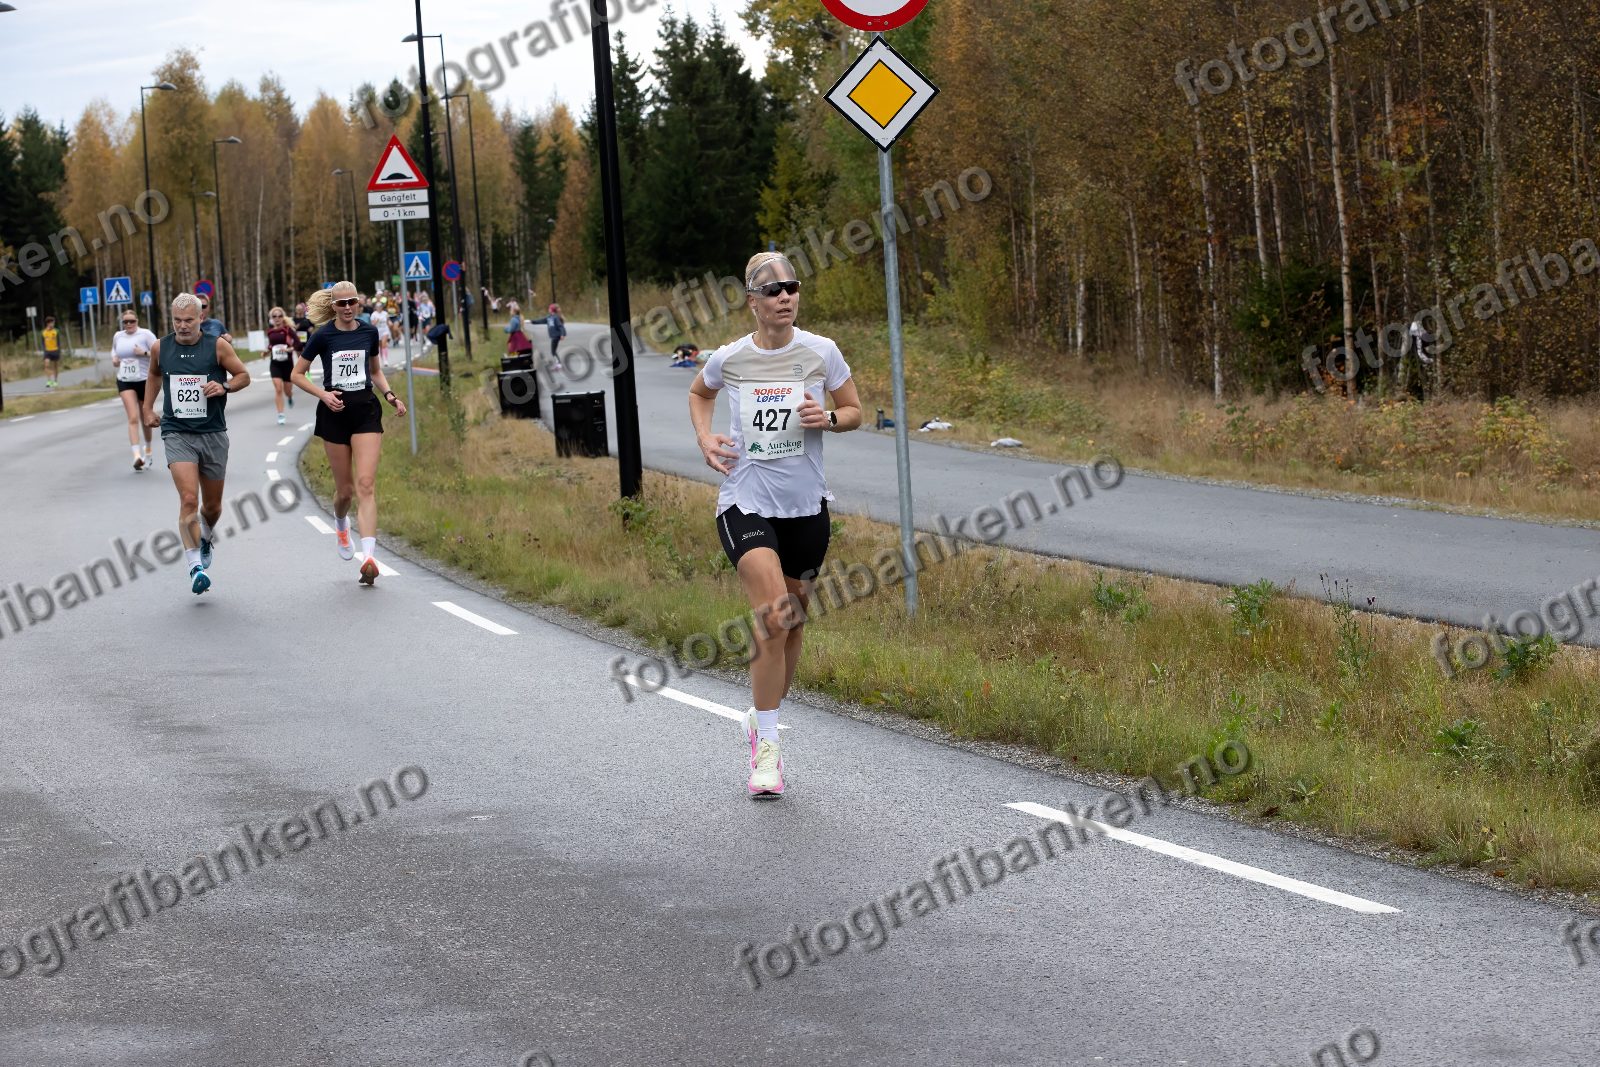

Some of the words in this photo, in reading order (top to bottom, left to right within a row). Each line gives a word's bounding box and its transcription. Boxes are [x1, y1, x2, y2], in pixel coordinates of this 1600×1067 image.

[380, 193, 416, 203] Gangfelt
[383, 210, 389, 218] 0
[123, 365, 136, 373] 710
[338, 364, 359, 377] 704
[177, 389, 200, 403] 623
[752, 387, 793, 396] NORGES
[756, 394, 786, 403] LØPET
[752, 408, 792, 432] 427
[767, 439, 802, 450] Aurskog
